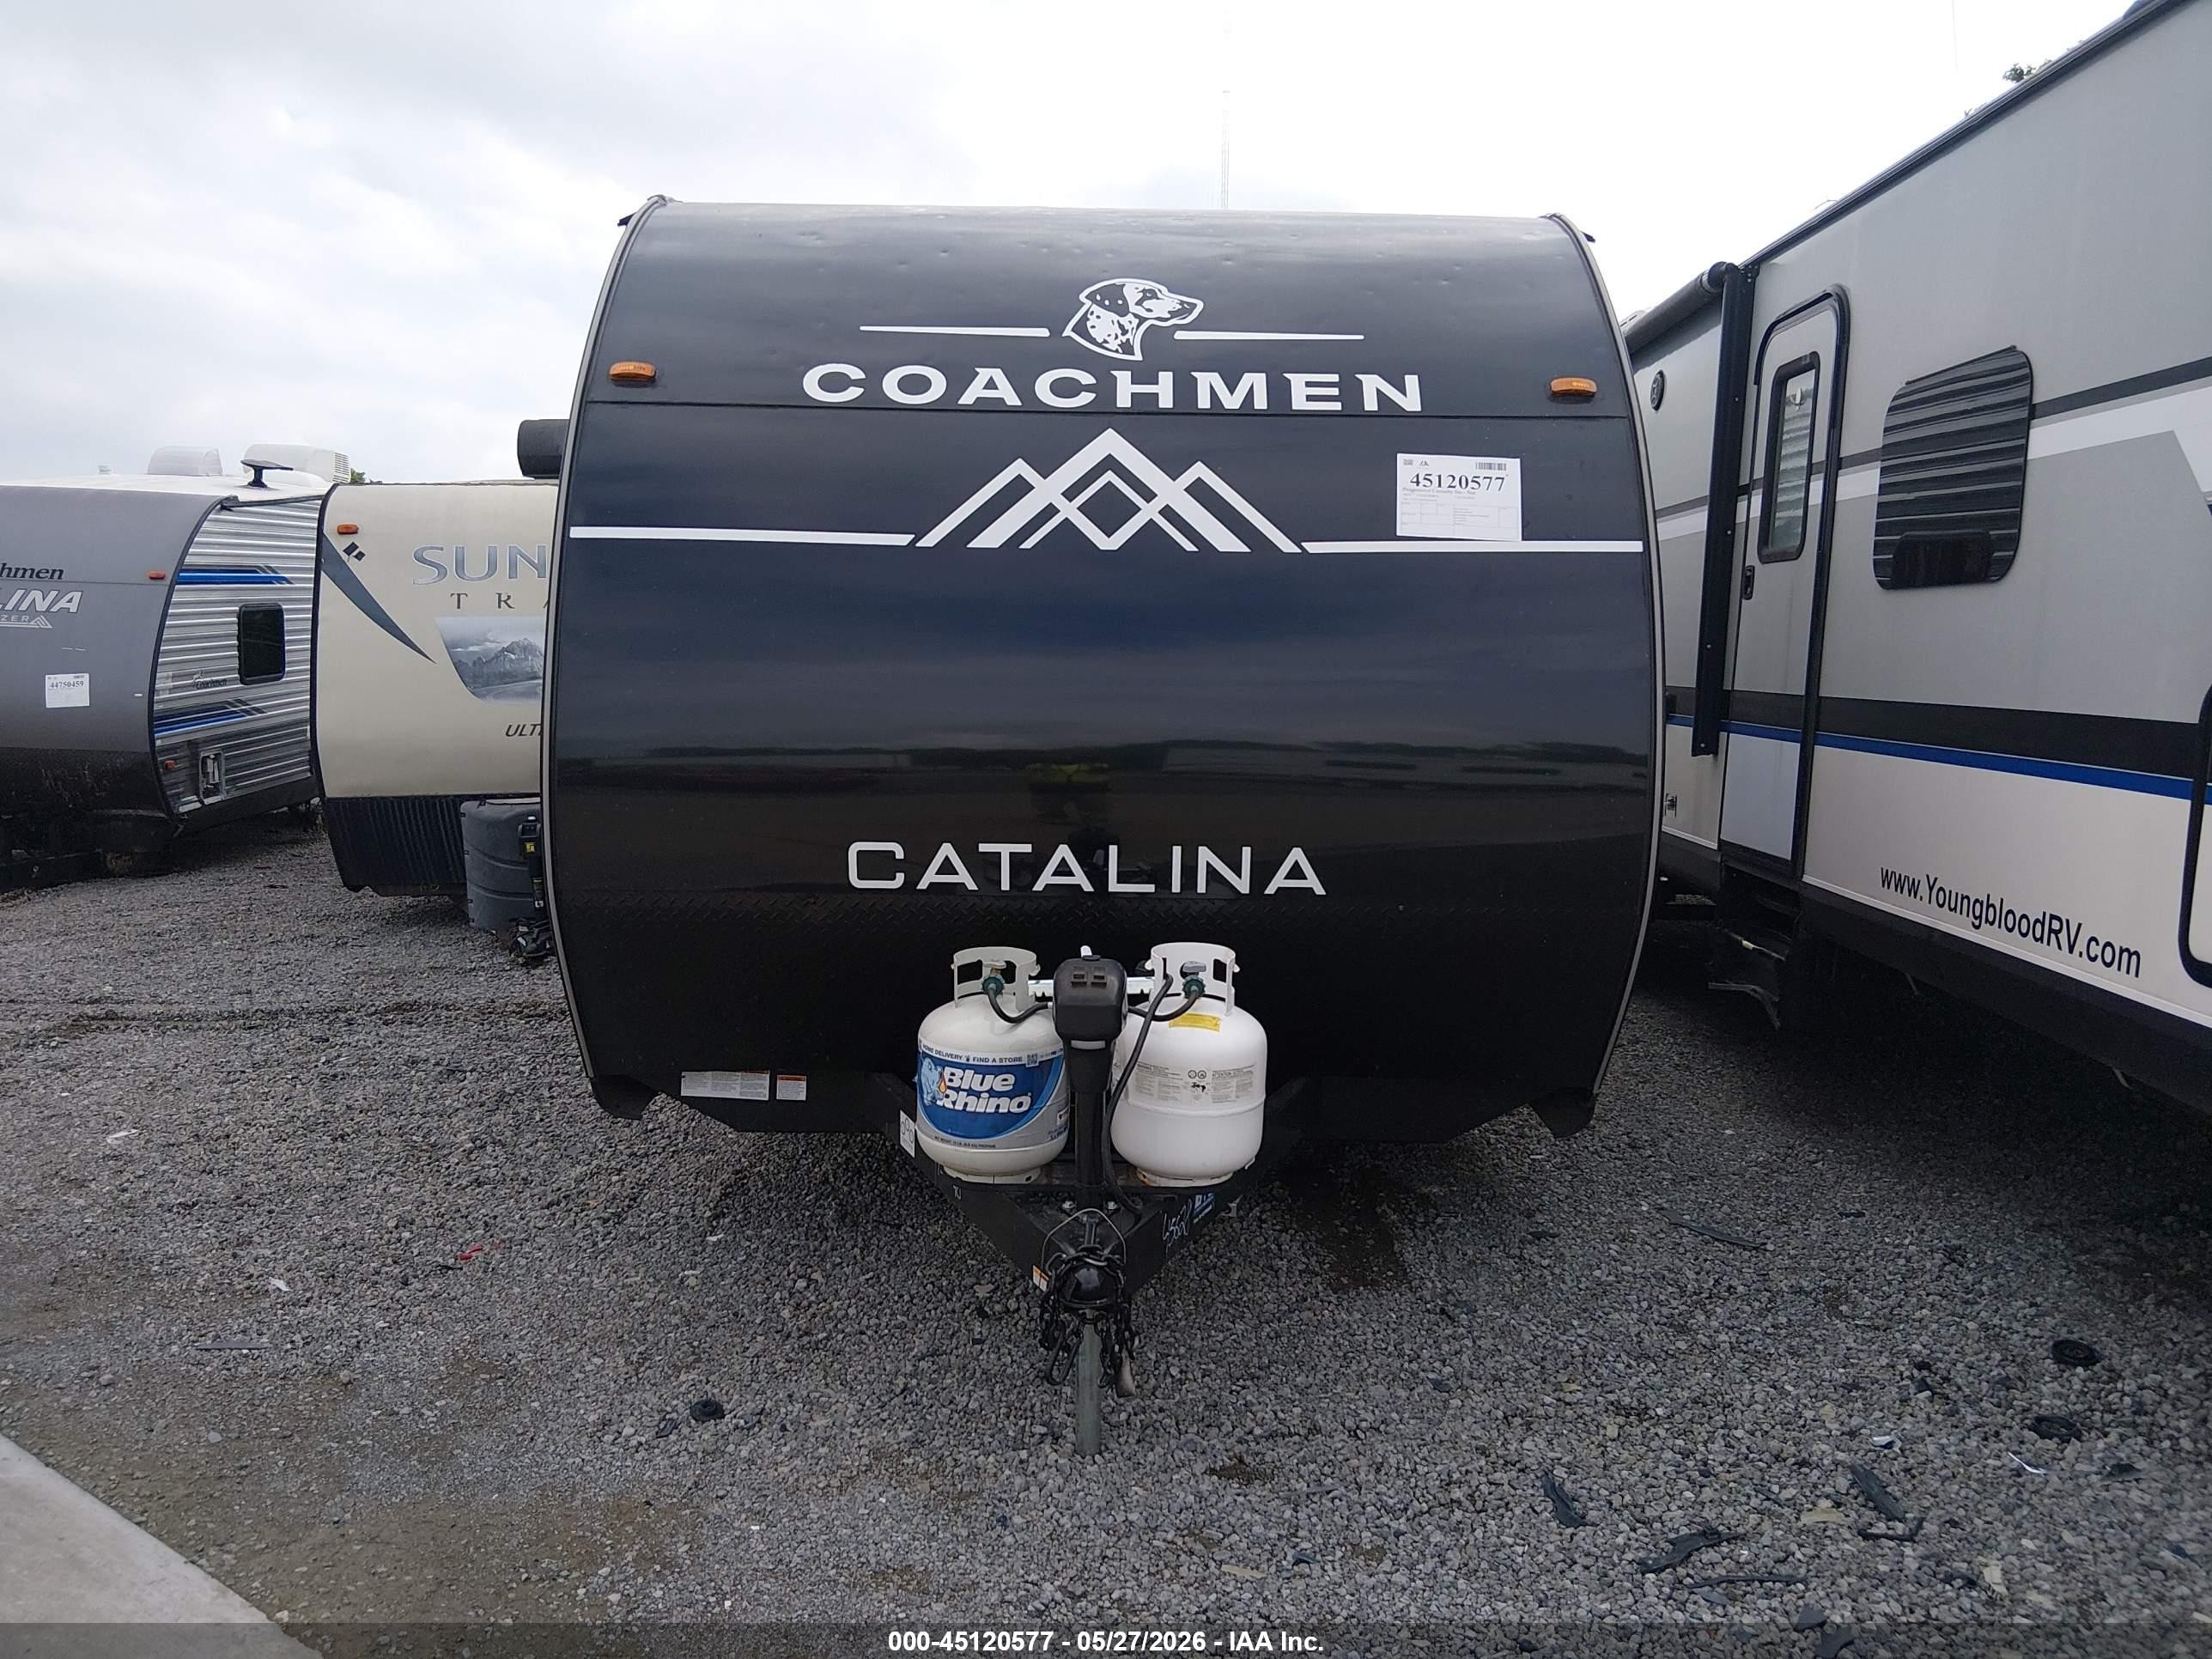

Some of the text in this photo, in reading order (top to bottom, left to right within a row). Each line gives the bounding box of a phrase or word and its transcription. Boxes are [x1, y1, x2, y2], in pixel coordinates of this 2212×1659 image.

[802, 362, 1423, 413] COACHMEN
[1410, 472, 1505, 492] 45120577
[0, 588, 83, 613] INA
[450, 592, 550, 610] TR
[505, 723, 542, 738] ULT
[848, 842, 1327, 896] CATALINA
[1881, 866, 2142, 978] www.YoungbloodRV.com
[934, 1048, 963, 1060] DELIVERY
[943, 1066, 1016, 1092] Blue
[937, 1091, 1031, 1114] Rhino
